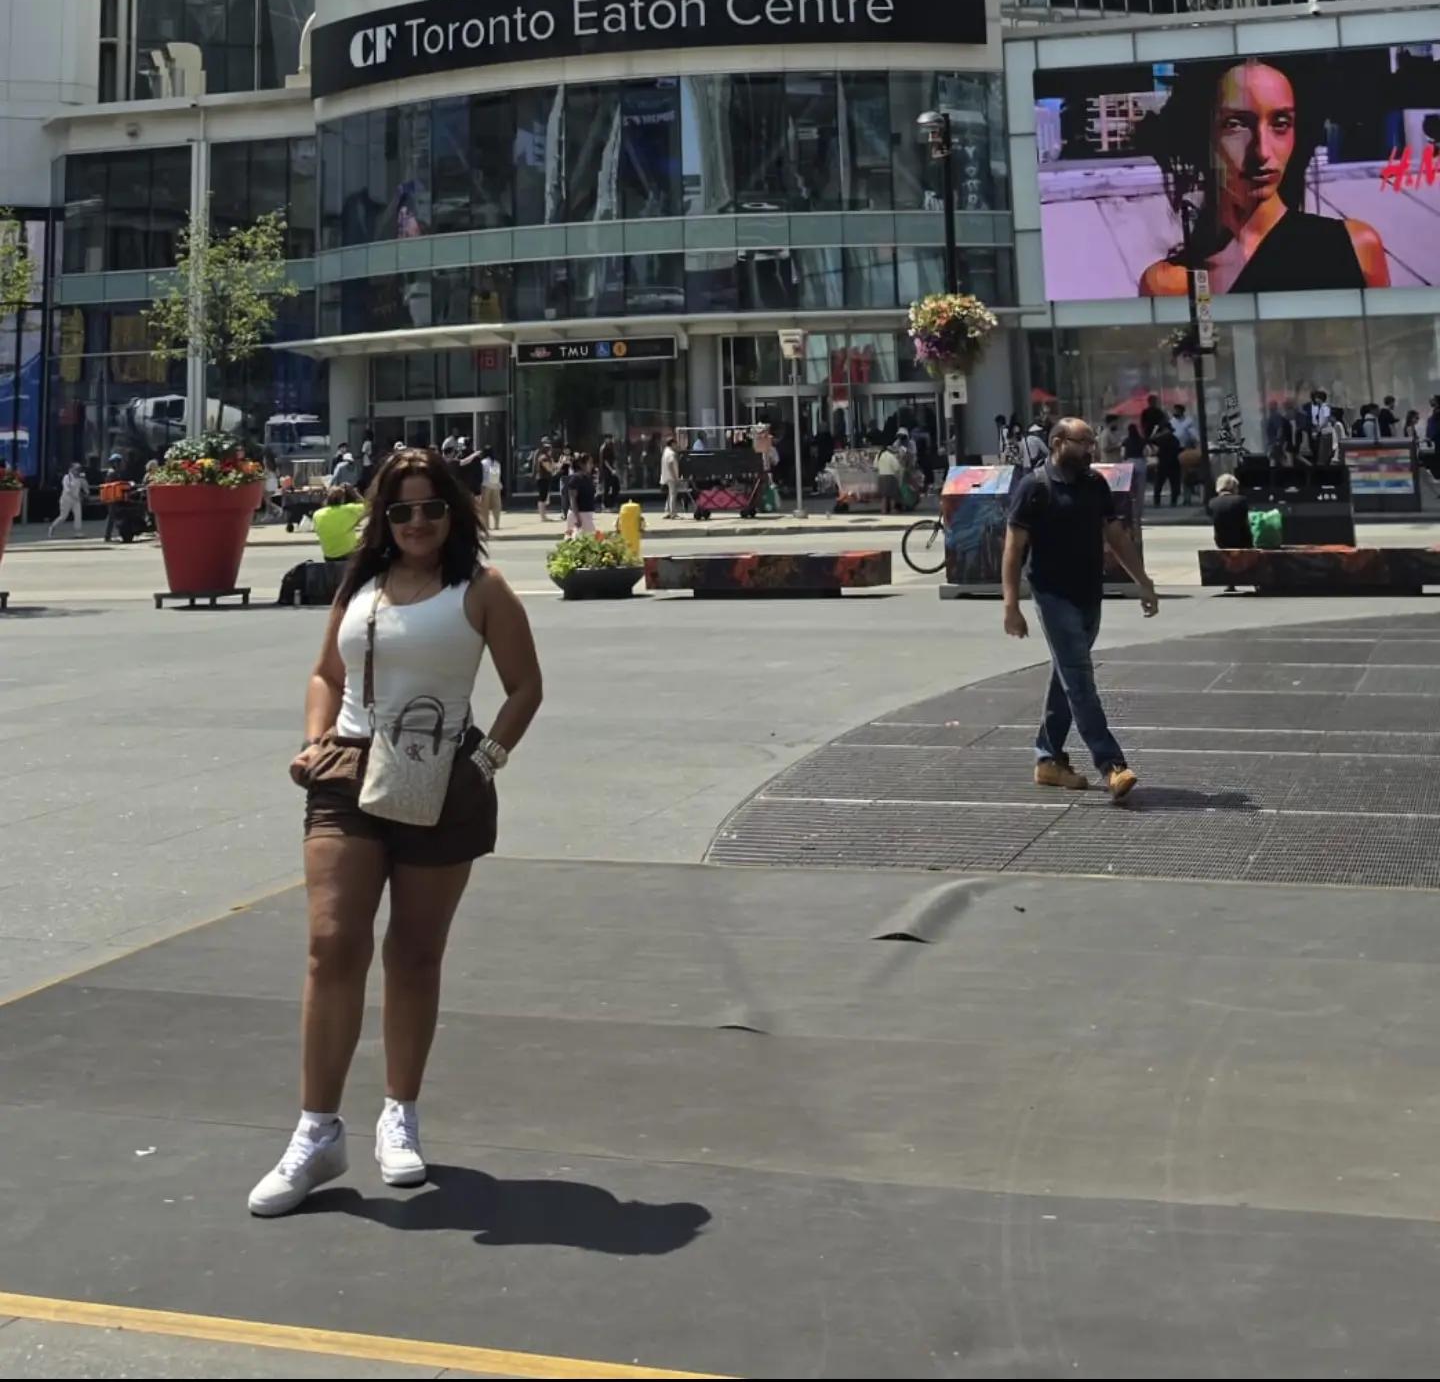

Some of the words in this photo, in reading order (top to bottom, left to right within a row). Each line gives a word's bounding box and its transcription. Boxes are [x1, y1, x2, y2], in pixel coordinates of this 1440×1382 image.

[350, 24, 396, 68] CF
[405, 6, 555, 57] Toronto
[559, 345, 589, 358] TMU
